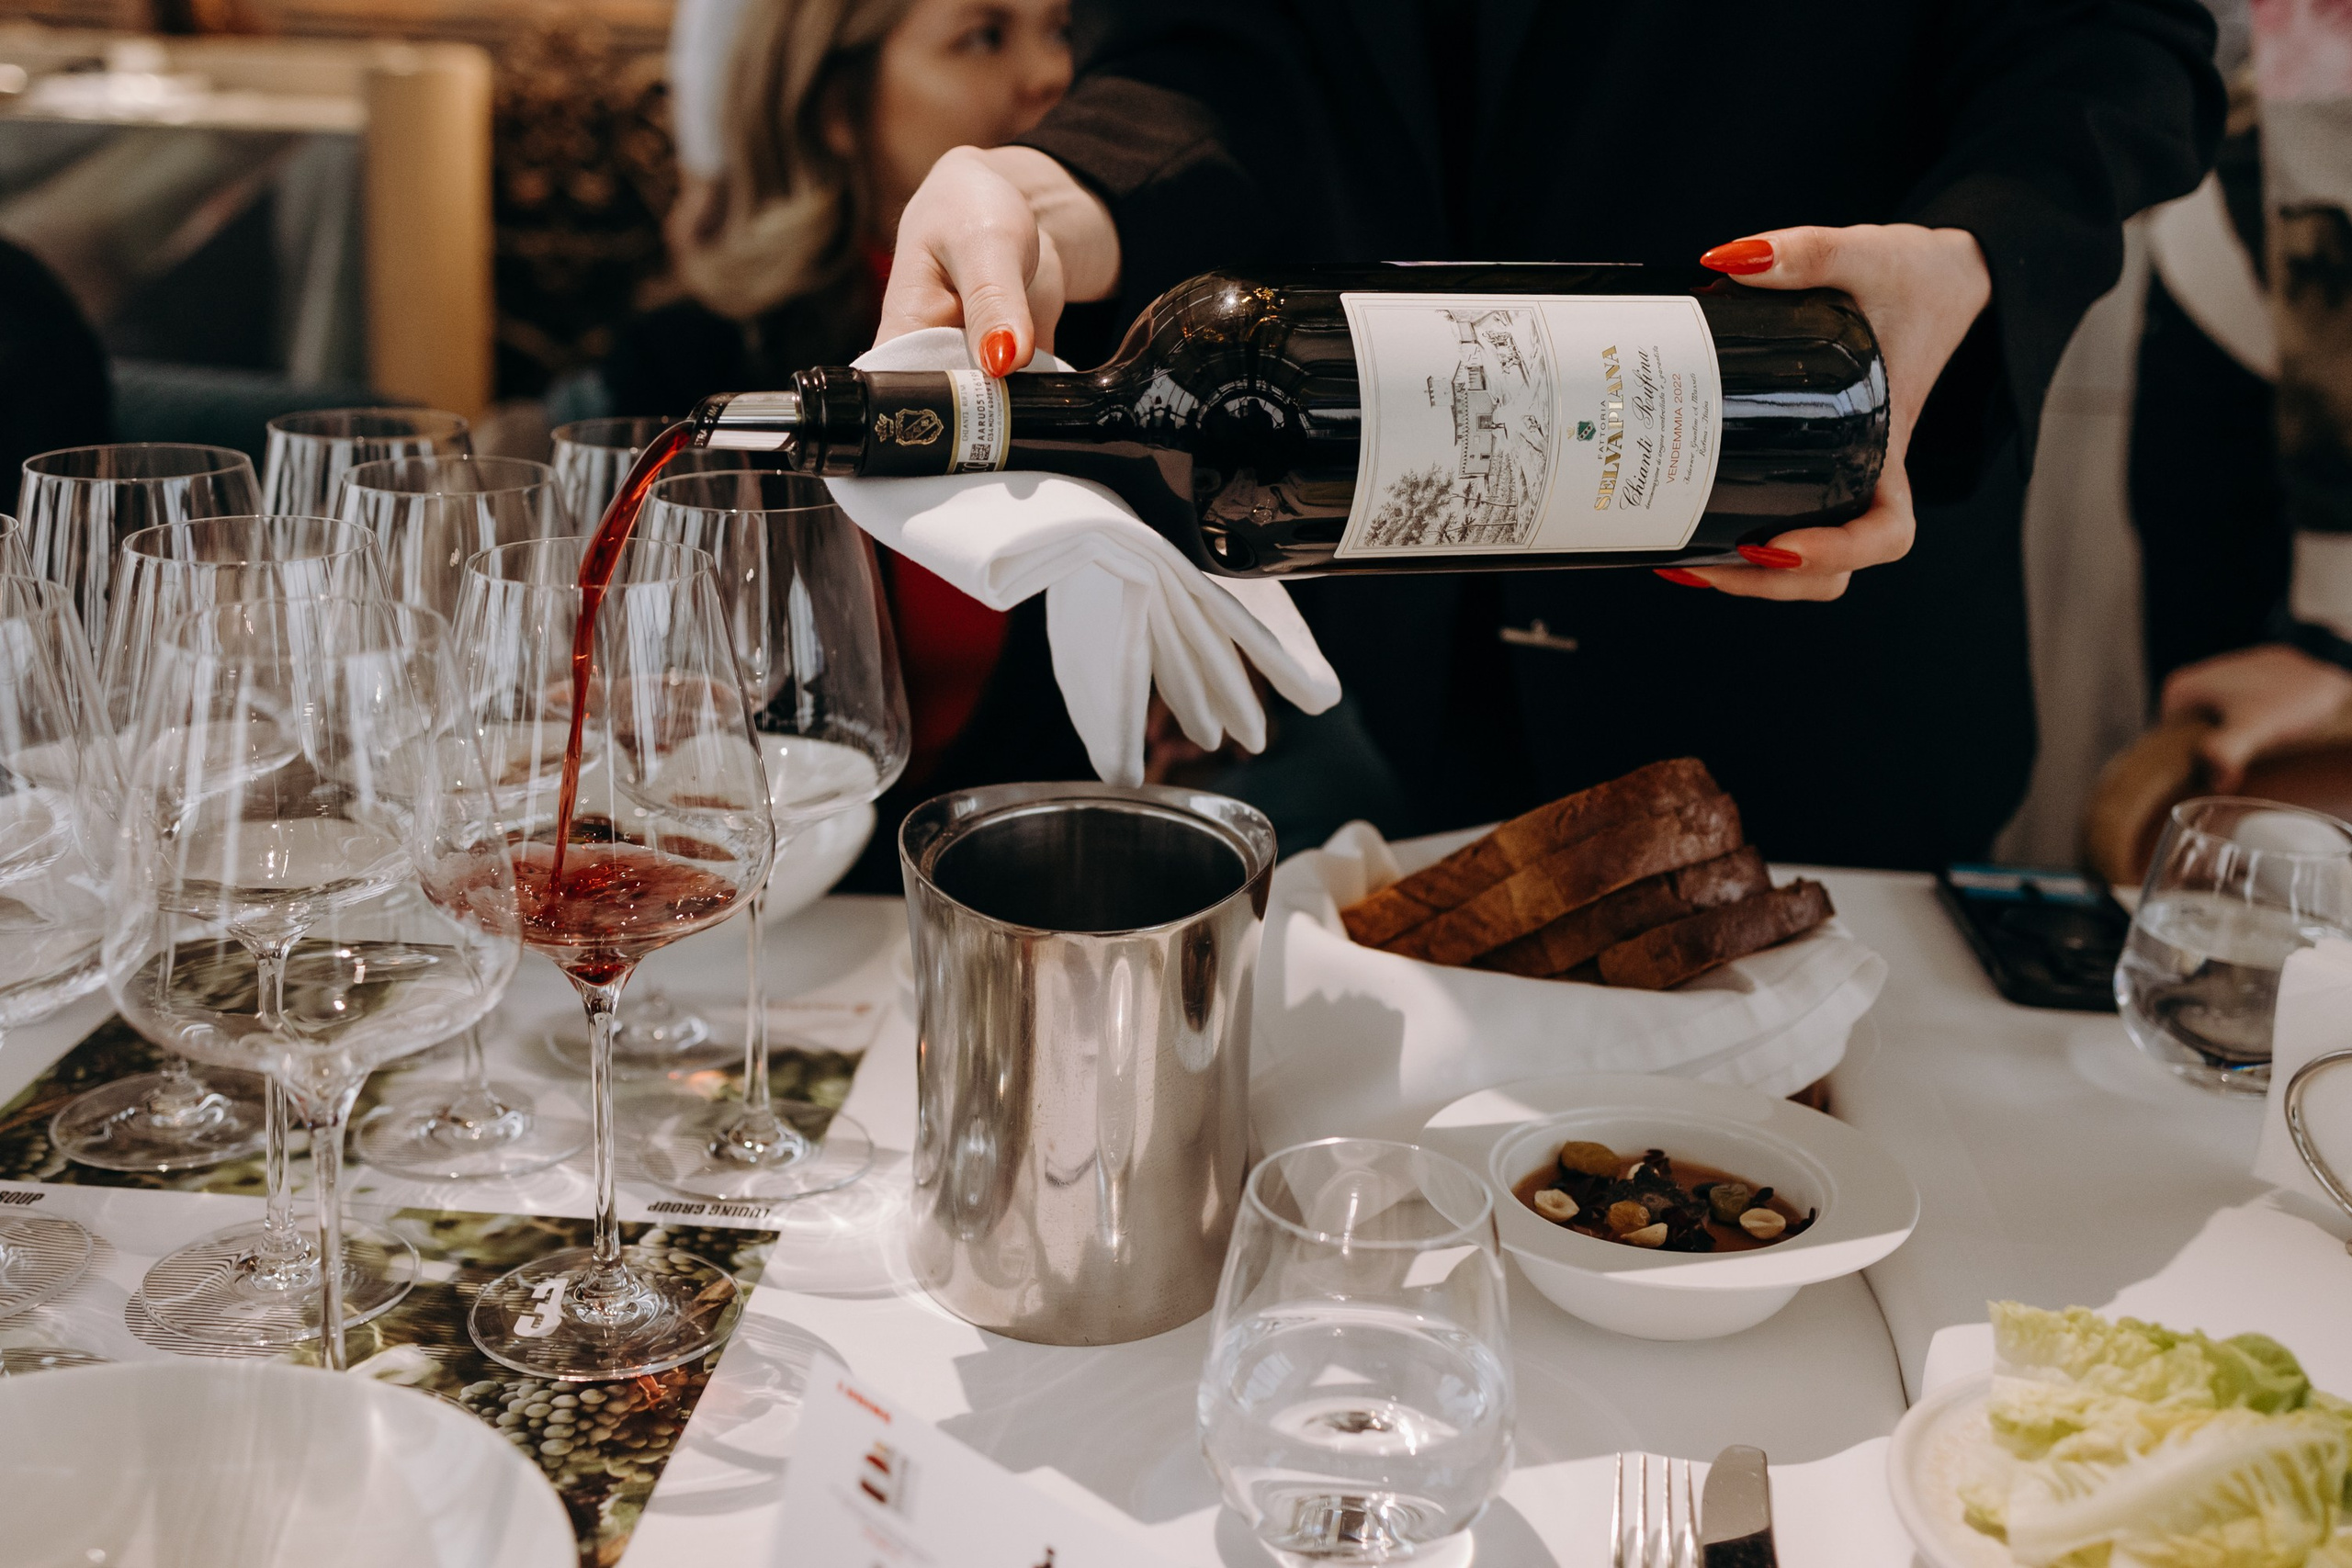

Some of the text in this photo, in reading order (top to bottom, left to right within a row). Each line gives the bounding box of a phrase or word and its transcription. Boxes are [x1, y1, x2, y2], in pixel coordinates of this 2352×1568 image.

[1594, 344, 1624, 511] SELVAPIANA
[1598, 400, 1607, 460] FATTORIA
[1619, 345, 1659, 511] Chianti Rufina
[1667, 373, 1683, 484] VENDEMMIA 2022
[0, 1190, 45, 1205] ROUP
[647, 1201, 707, 1215] GROUP
[513, 1278, 570, 1337] 3
